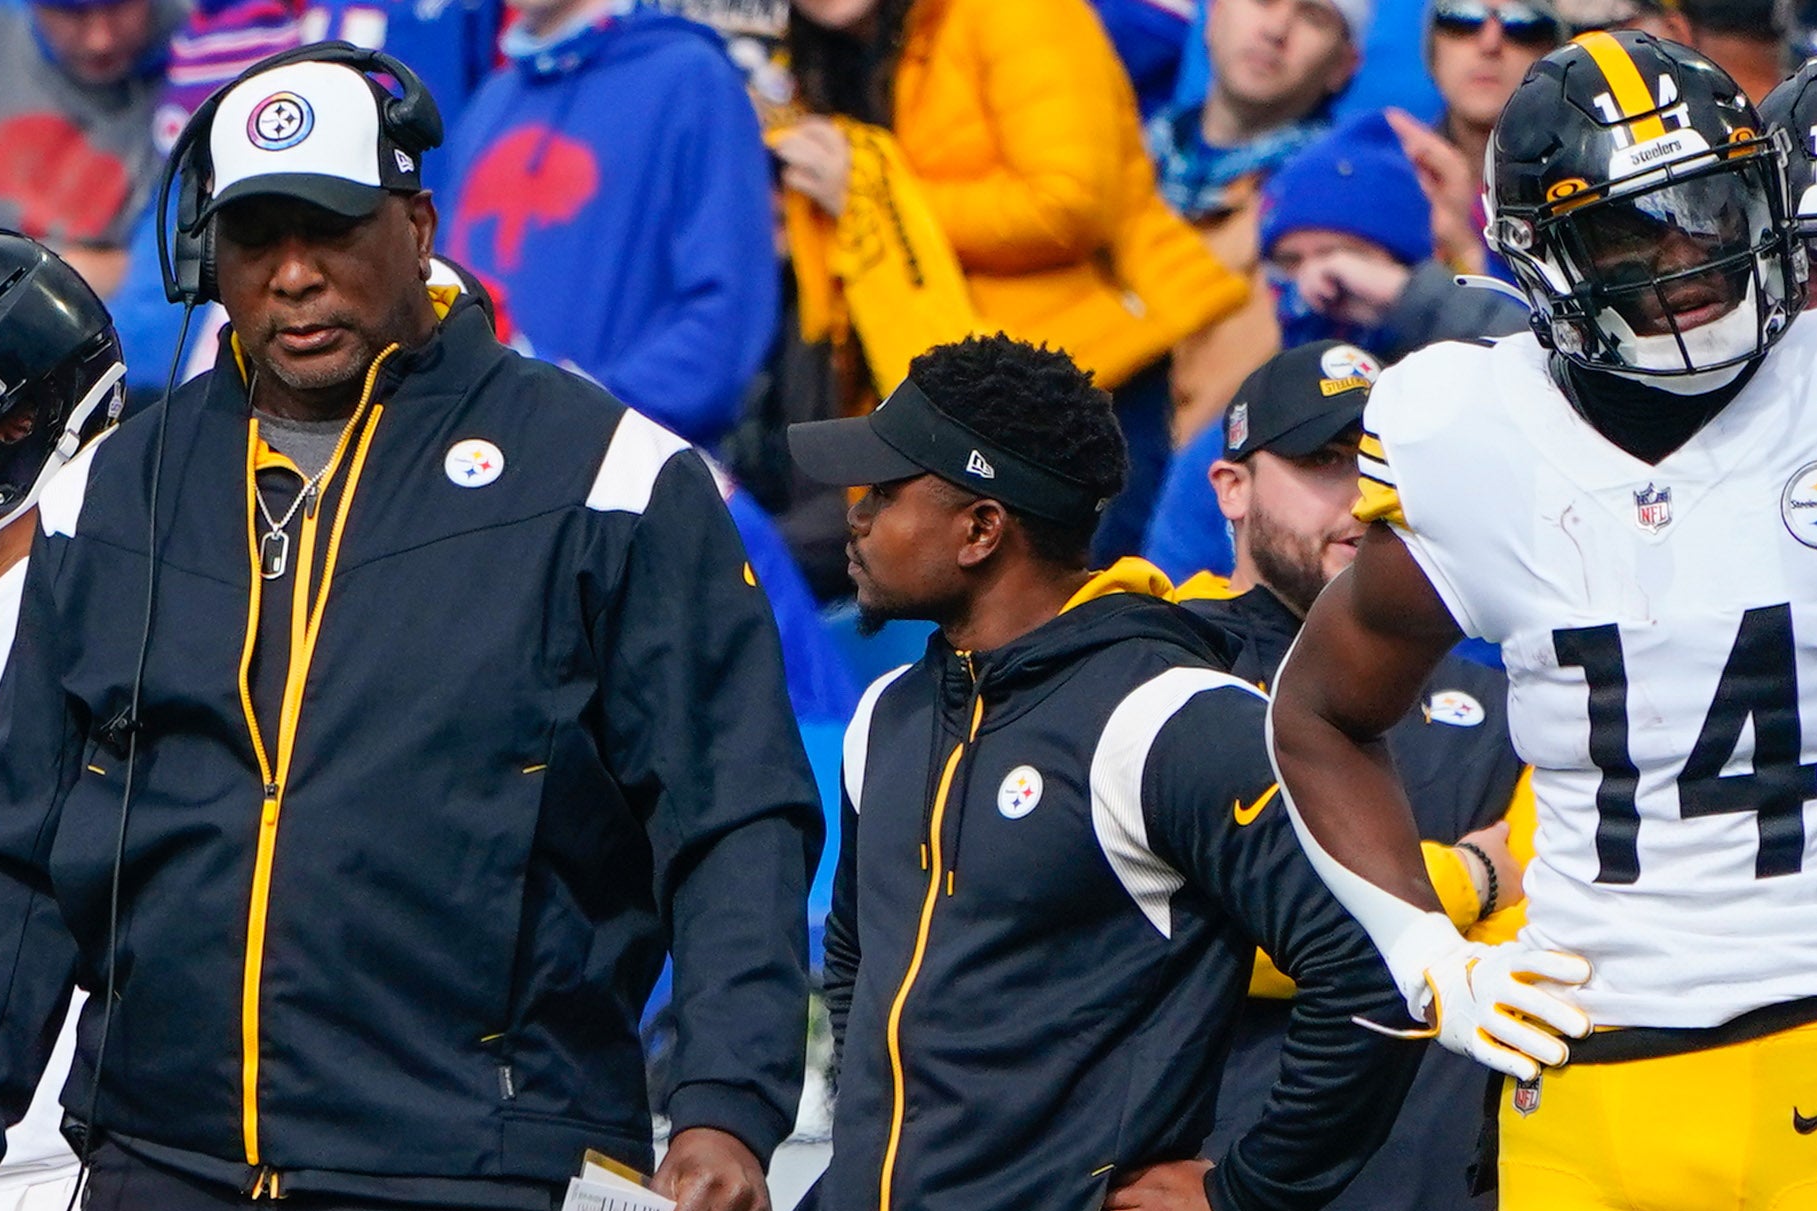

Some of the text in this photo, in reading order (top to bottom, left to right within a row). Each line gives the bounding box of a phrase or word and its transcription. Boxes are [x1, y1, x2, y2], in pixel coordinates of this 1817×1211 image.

[1593, 73, 1692, 150] 14
[1631, 140, 1682, 165] Steelers
[1640, 504, 1667, 525] NFL
[1552, 602, 1817, 885] 14
